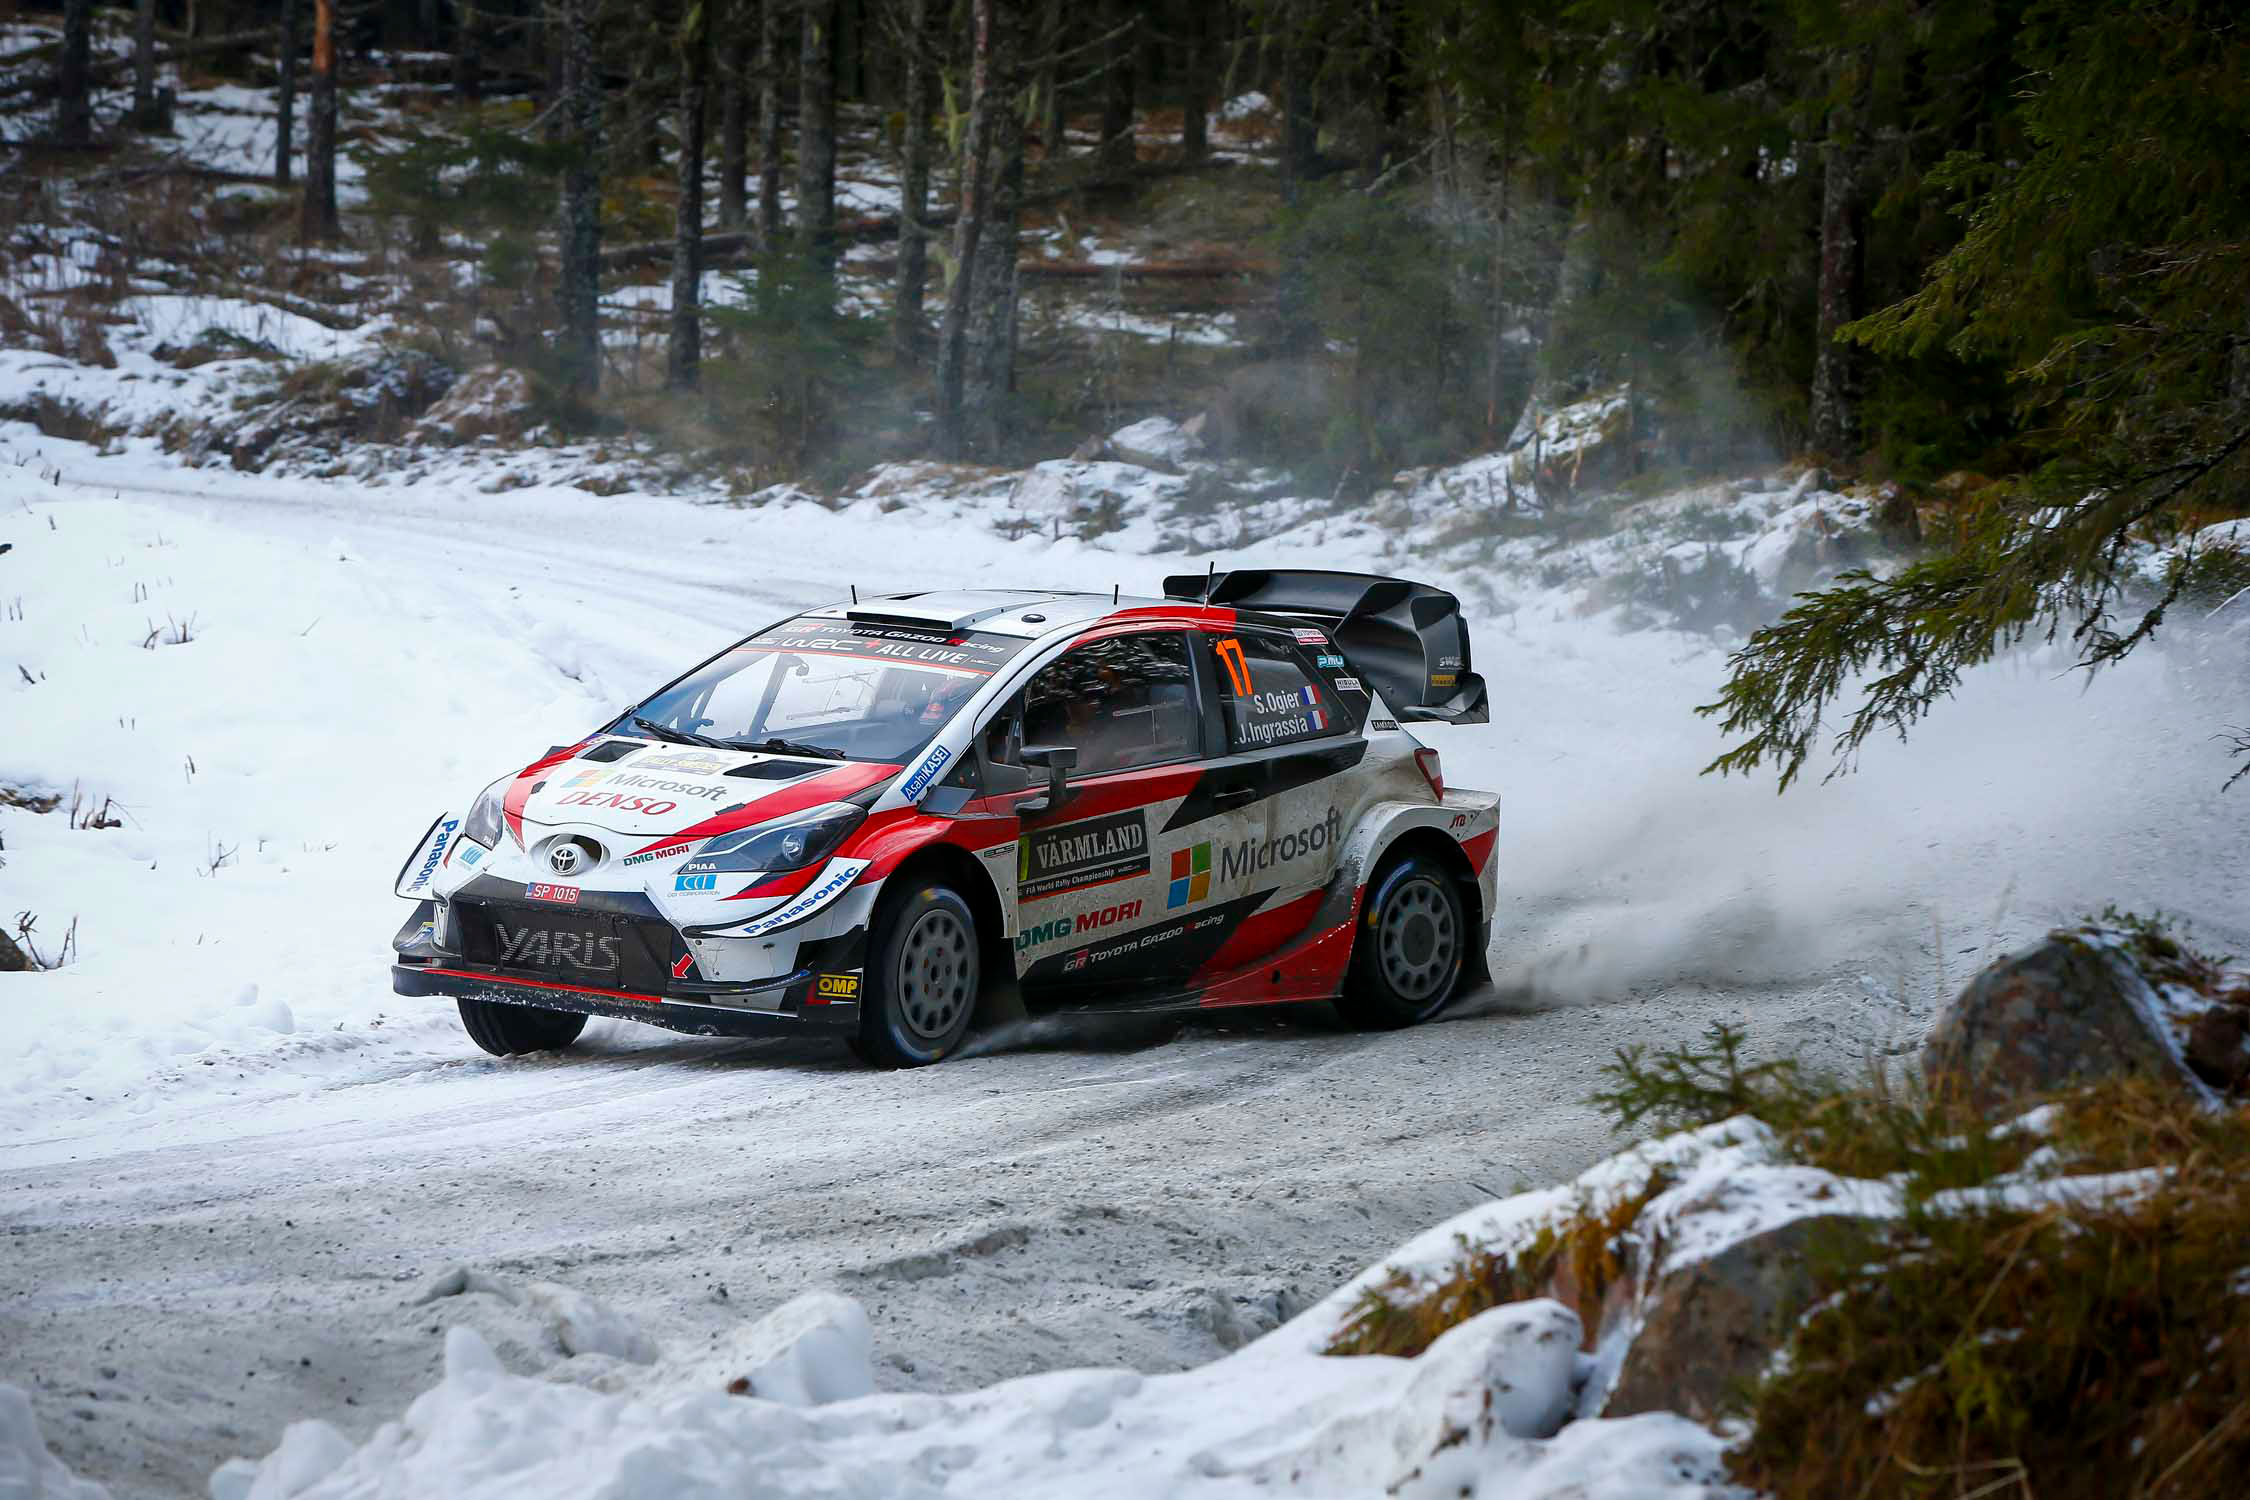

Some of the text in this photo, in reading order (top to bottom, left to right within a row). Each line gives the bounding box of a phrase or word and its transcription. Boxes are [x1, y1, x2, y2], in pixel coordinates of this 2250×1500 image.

[821, 627, 881, 637] TOYOTA
[885, 631, 947, 643] GAZOO
[875, 644, 915, 657] ALL
[918, 648, 968, 663] LIVE
[1216, 639, 1253, 697] 17
[1254, 690, 1300, 715] S.Ogier
[1240, 715, 1309, 744] J.Ingrassia
[606, 774, 728, 801] Microsoft
[556, 791, 677, 815] DENSO
[406, 819, 459, 892] Panasonic
[624, 845, 690, 866] DMG MORI
[1036, 823, 1143, 869] VÄRMLAND
[1221, 805, 1342, 883] Microsoft
[688, 863, 717, 871] PIAA
[1055, 878, 1071, 889] Rally
[1072, 868, 1115, 884] Championship
[533, 884, 577, 901] SP 1015
[743, 866, 859, 934] Panasonic
[1015, 899, 1143, 950] DMG MORI
[1091, 942, 1138, 963] TOYOTA
[1140, 926, 1184, 947] GAZOO
[818, 978, 857, 994] OMP
